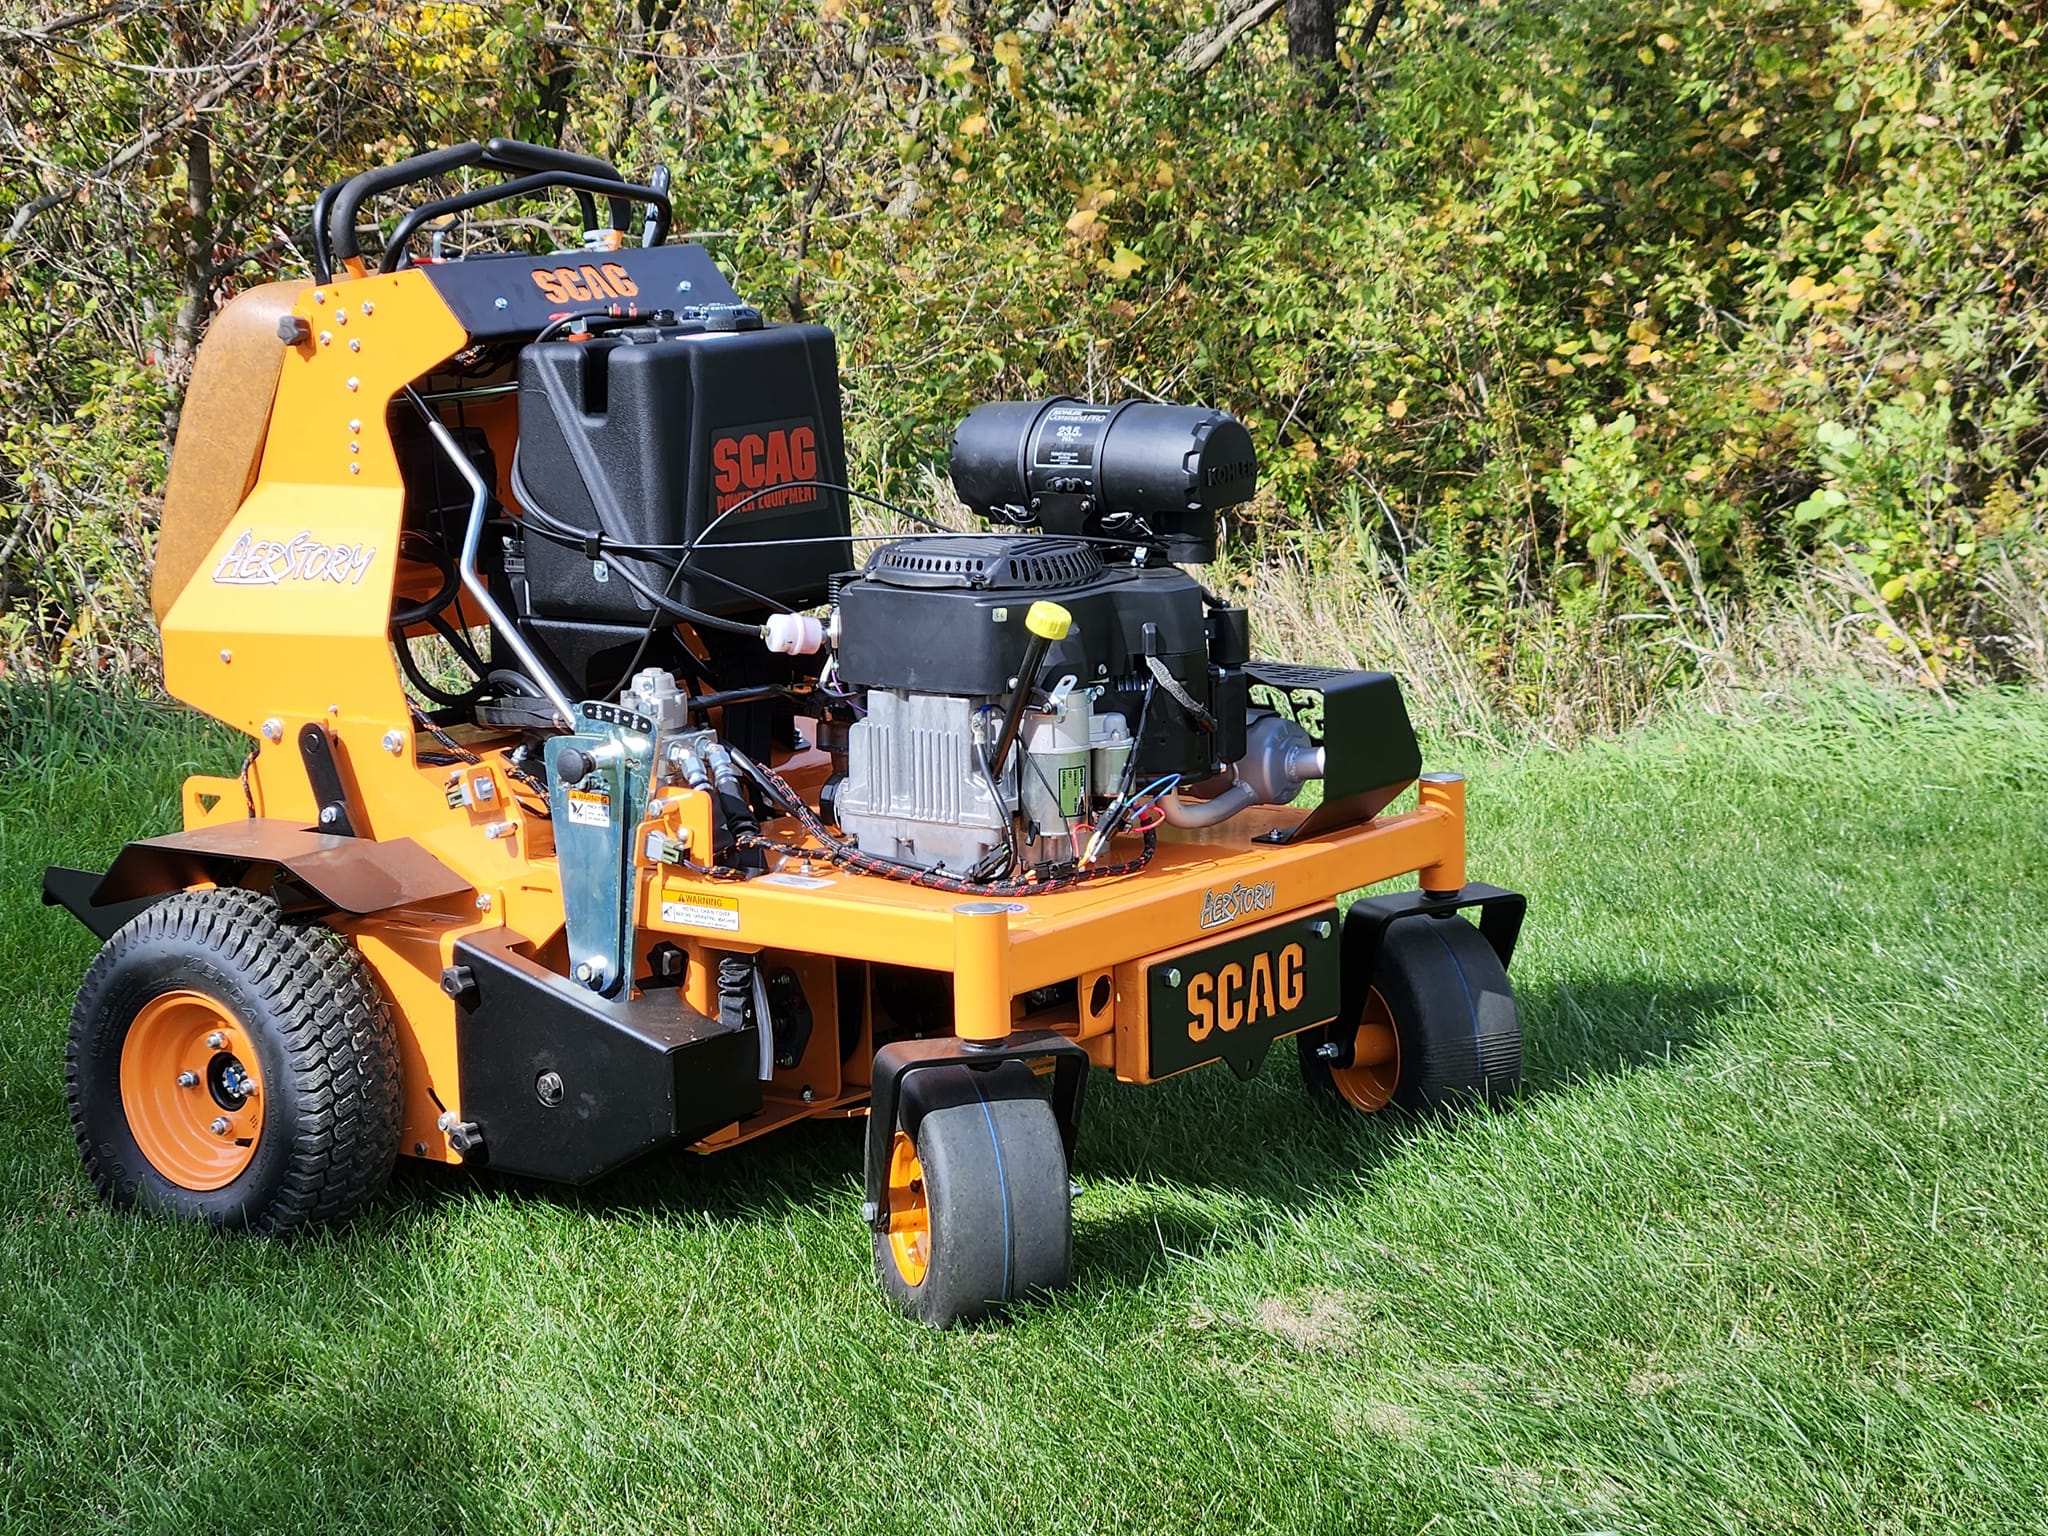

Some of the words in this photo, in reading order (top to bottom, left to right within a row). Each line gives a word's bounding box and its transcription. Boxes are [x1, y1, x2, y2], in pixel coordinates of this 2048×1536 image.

[531, 263, 639, 304] SCAG
[713, 426, 817, 492] SCAG
[717, 489, 755, 516] POWER
[757, 484, 817, 509] EQUIPMENT
[685, 895, 724, 907] WARNING
[182, 953, 258, 1025] KENDA
[1187, 942, 1304, 1043] SCAG
